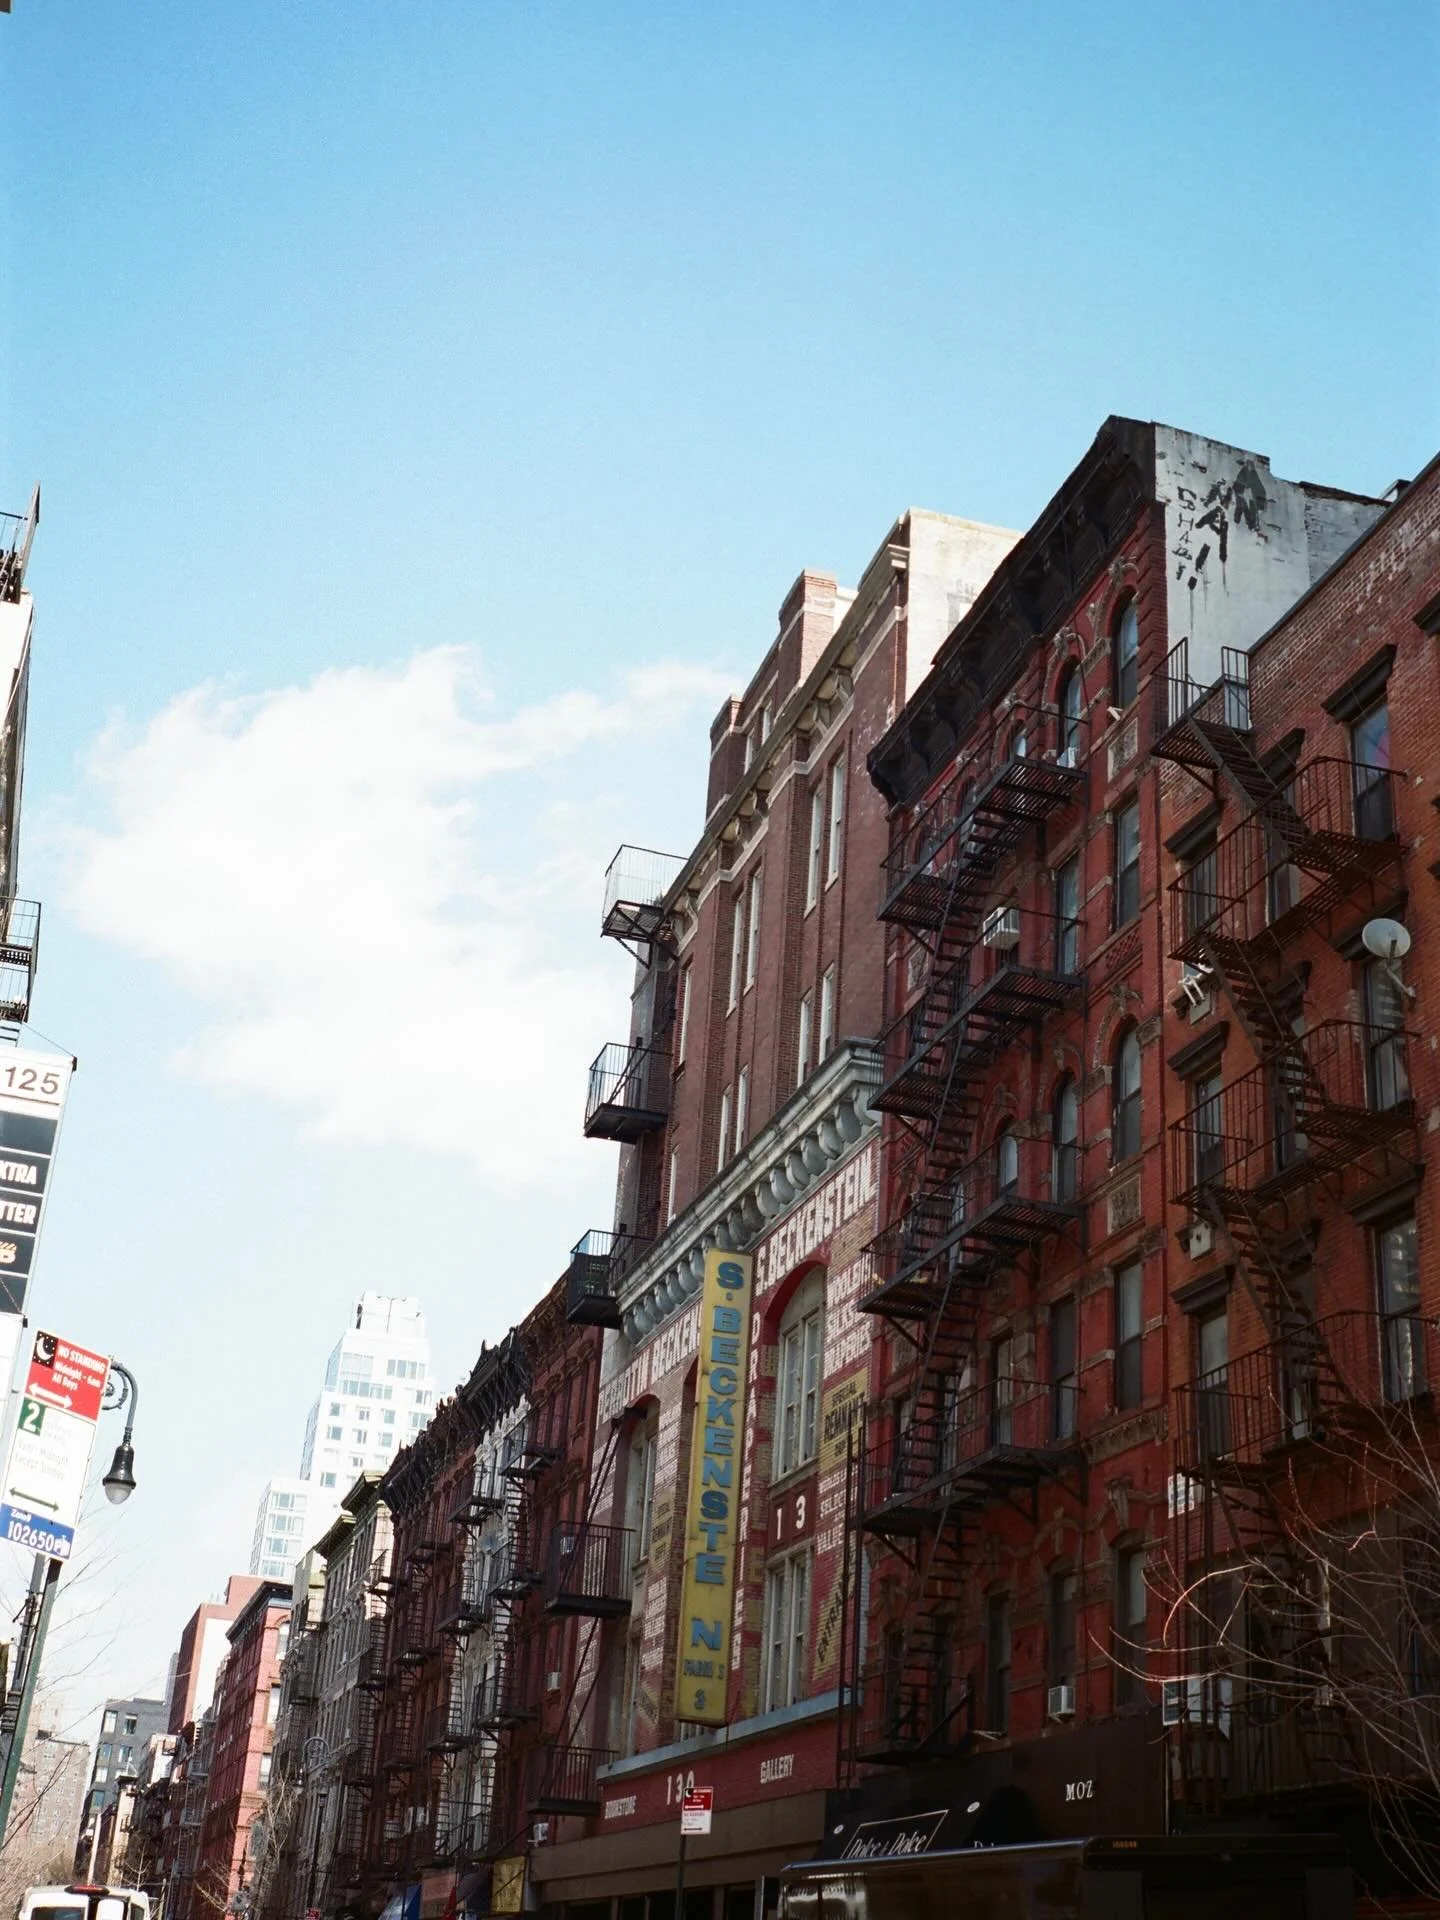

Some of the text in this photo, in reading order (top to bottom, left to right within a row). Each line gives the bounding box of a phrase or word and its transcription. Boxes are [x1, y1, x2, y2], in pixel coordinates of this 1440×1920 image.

[5, 1066, 60, 1095] 125
[57, 1345, 106, 1374] NO STANDING
[23, 1402, 40, 1433] 2
[7, 1520, 55, 1551] 102650
[760, 1754, 795, 1784] GALLERY
[1065, 1780, 1093, 1802] MOZ
